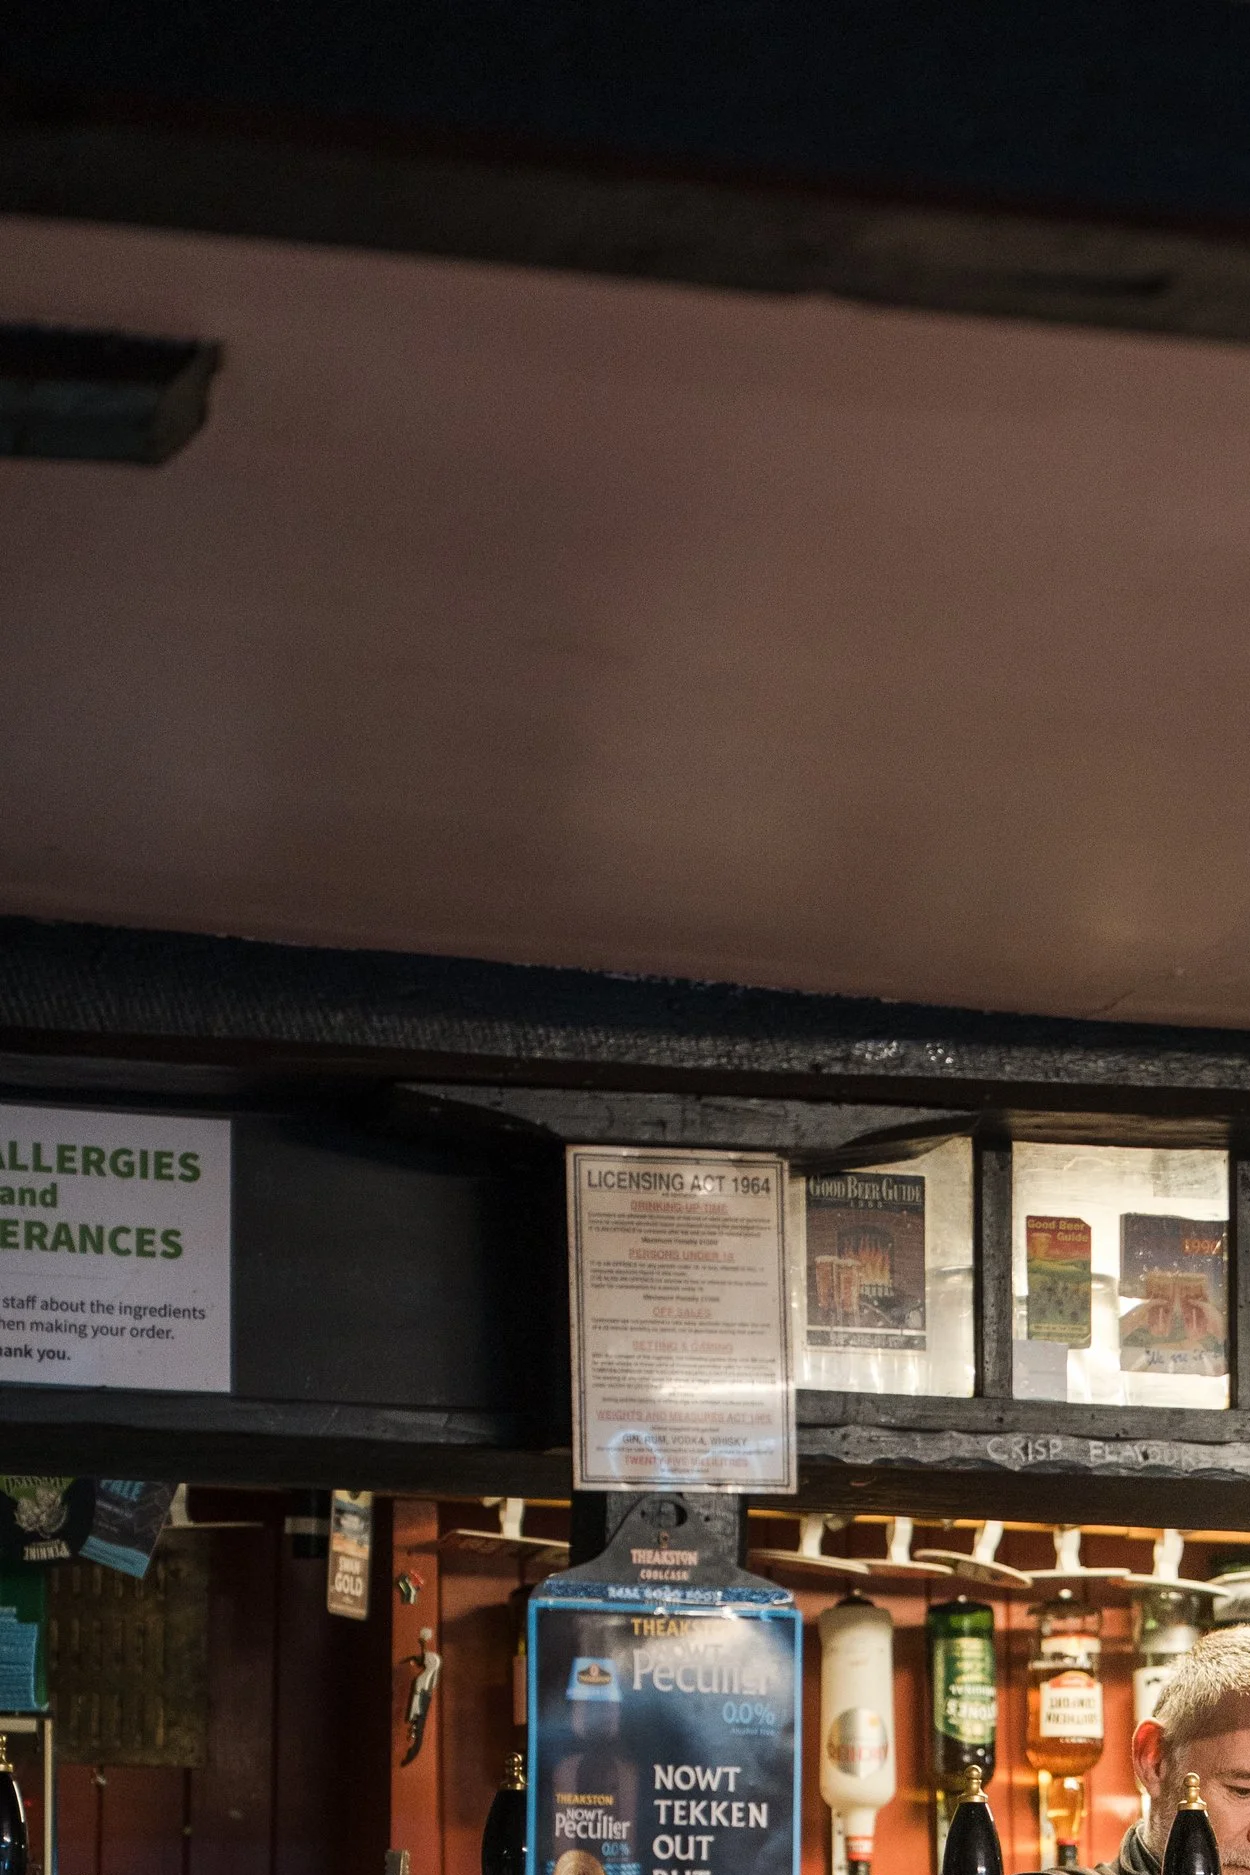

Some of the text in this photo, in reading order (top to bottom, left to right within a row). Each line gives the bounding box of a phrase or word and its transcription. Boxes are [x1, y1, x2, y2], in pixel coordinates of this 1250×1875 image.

[0, 1140, 202, 1182] LLERGIES
[588, 1171, 770, 1194] LICENSING ACT 1964
[0, 1182, 58, 1208] and
[1027, 1218, 1085, 1230] Good Beer
[2, 1294, 206, 1319] staff about the ingredients
[29, 1319, 87, 1339] making
[91, 1323, 126, 1338] your
[129, 1325, 175, 1340] order.
[36, 1348, 71, 1363] you.
[711, 1435, 748, 1446] WHISKY
[986, 1437, 1062, 1461] CRISP
[631, 1550, 698, 1566] THEAKSTON
[335, 1573, 363, 1597] GOLD
[653, 1764, 742, 1793] NOWT
[555, 1793, 616, 1806] THEAKSTON
[555, 1811, 631, 1840] Peculier
[566, 1808, 604, 1821] NOWT
[653, 1799, 768, 1829] TEKKEN
[652, 1834, 715, 1861] OUT
